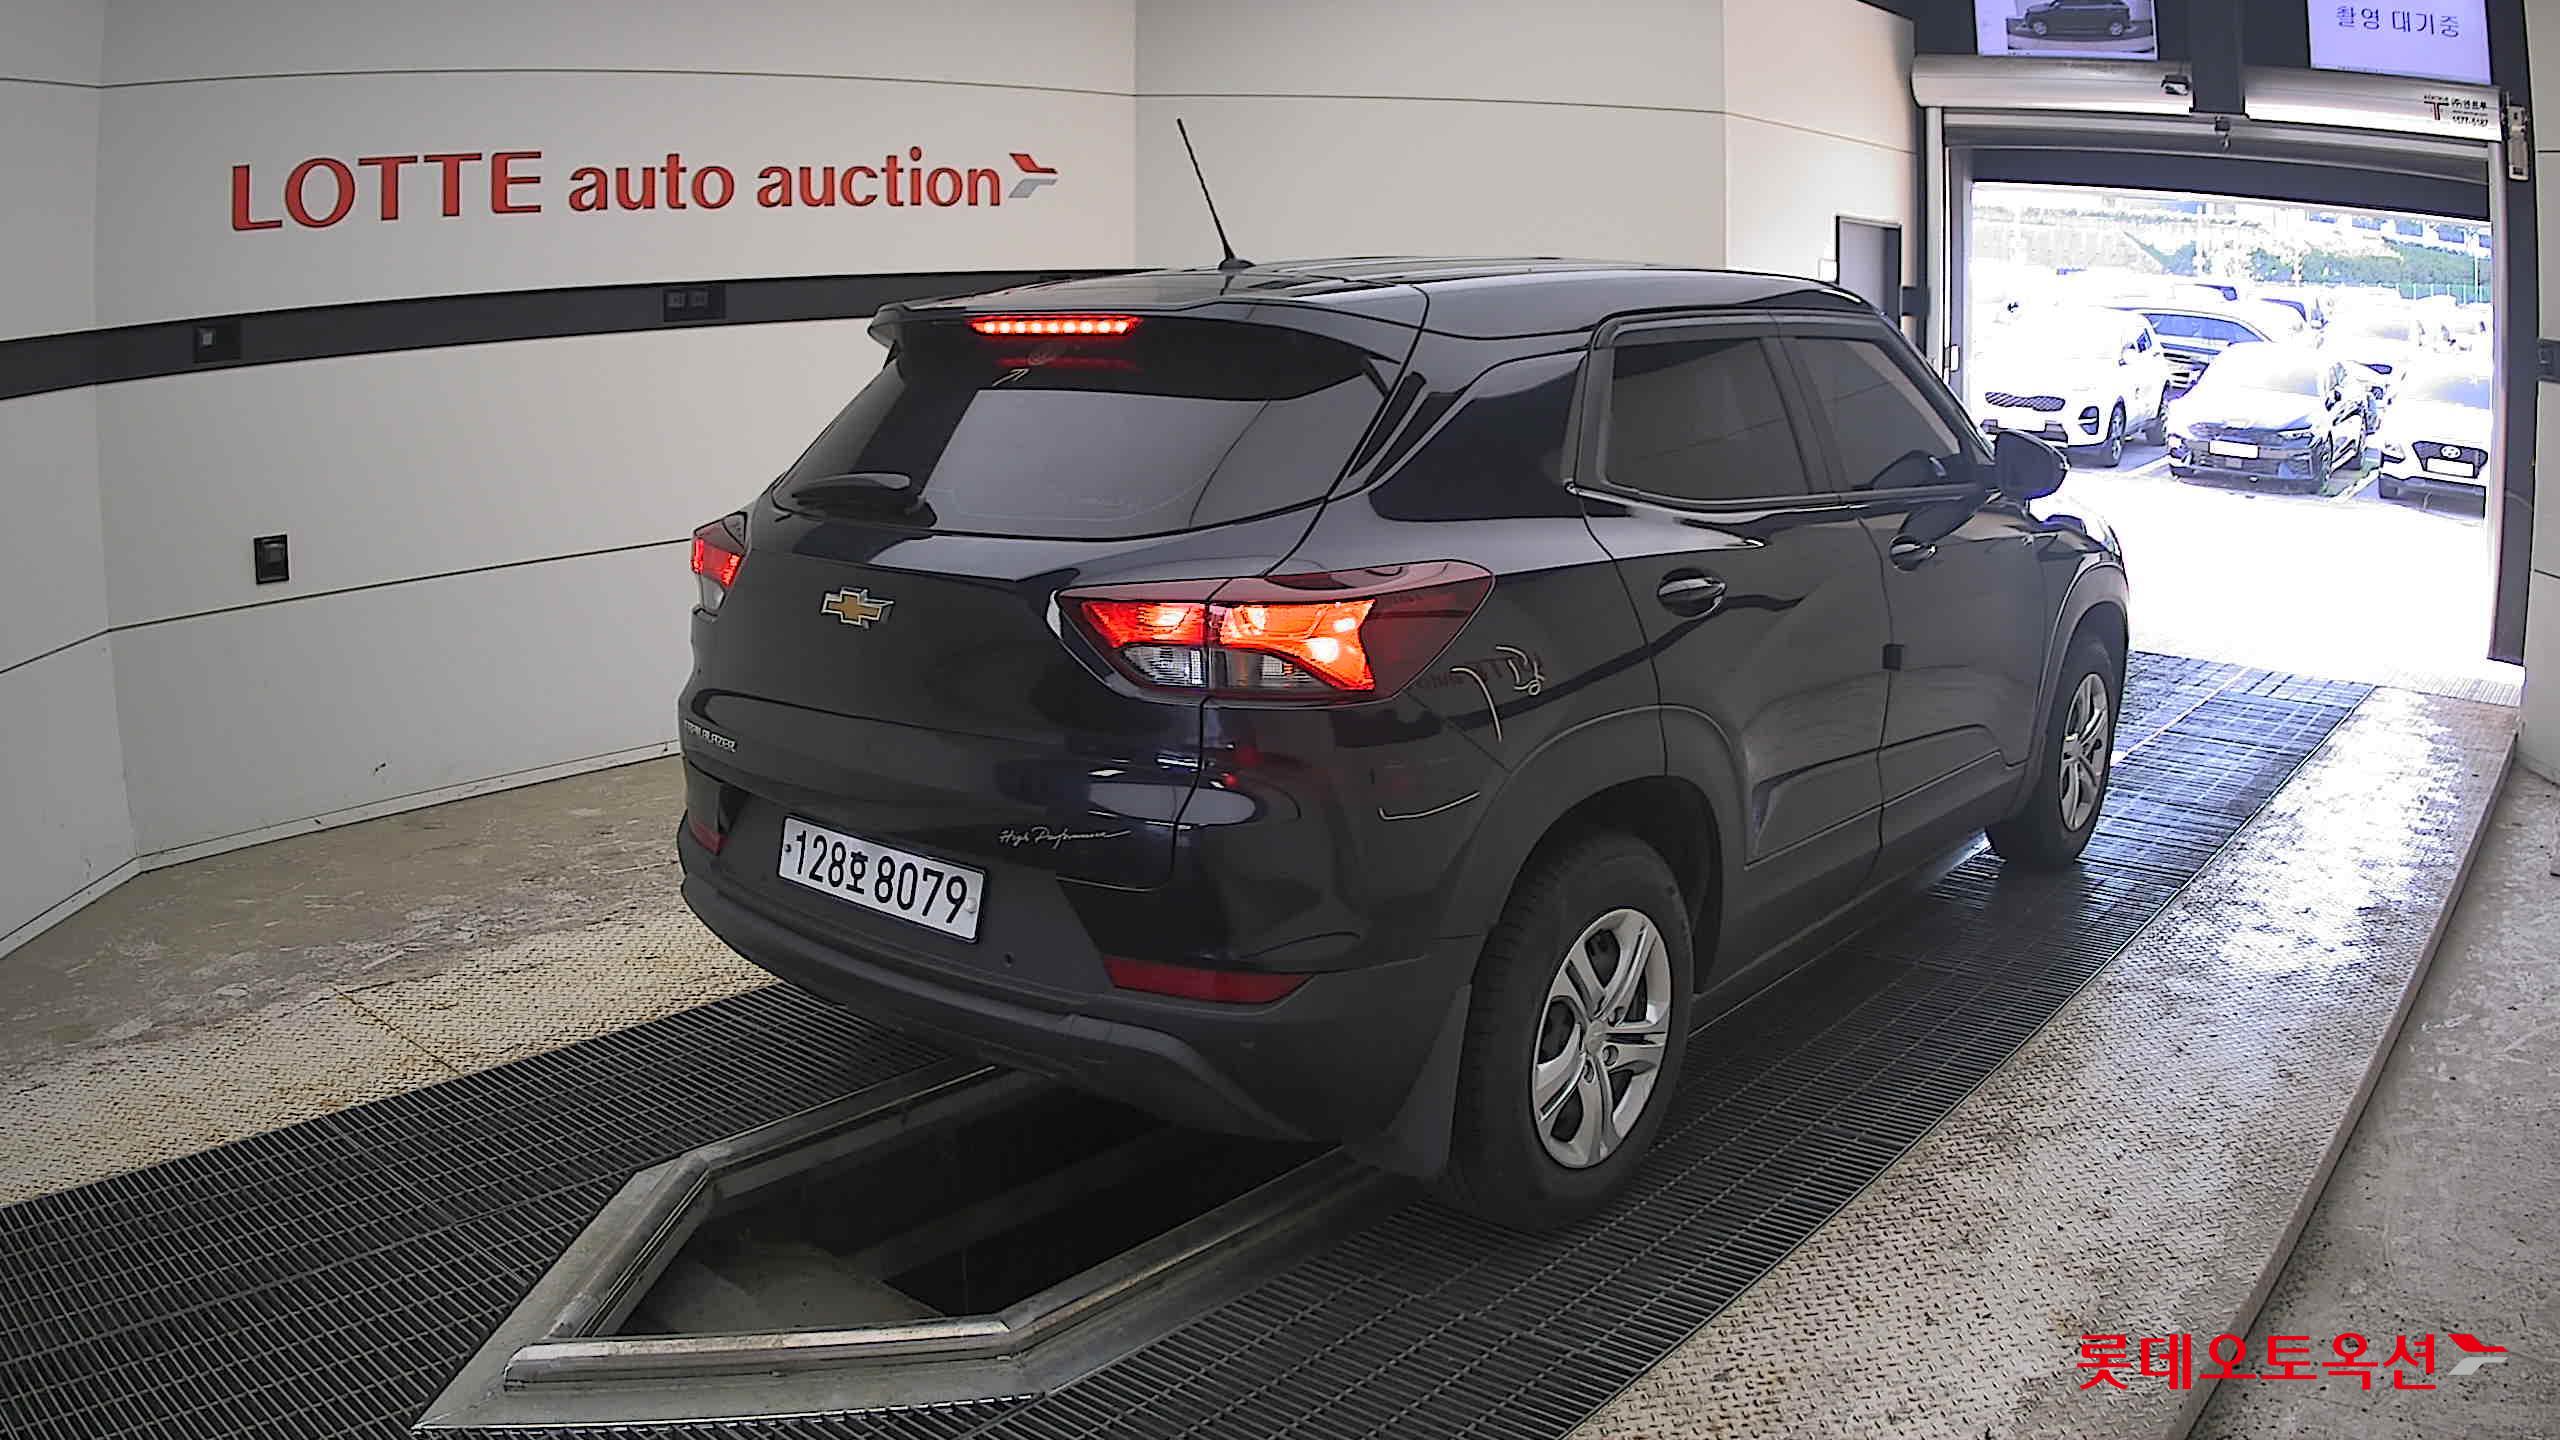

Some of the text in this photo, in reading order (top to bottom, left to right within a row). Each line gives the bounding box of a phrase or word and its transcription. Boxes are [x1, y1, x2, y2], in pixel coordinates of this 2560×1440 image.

[2337, 5, 2459, 38] 촬영 대기중
[232, 146, 1001, 232] LOTTE auto auction
[796, 830, 968, 924] 128호 8079
